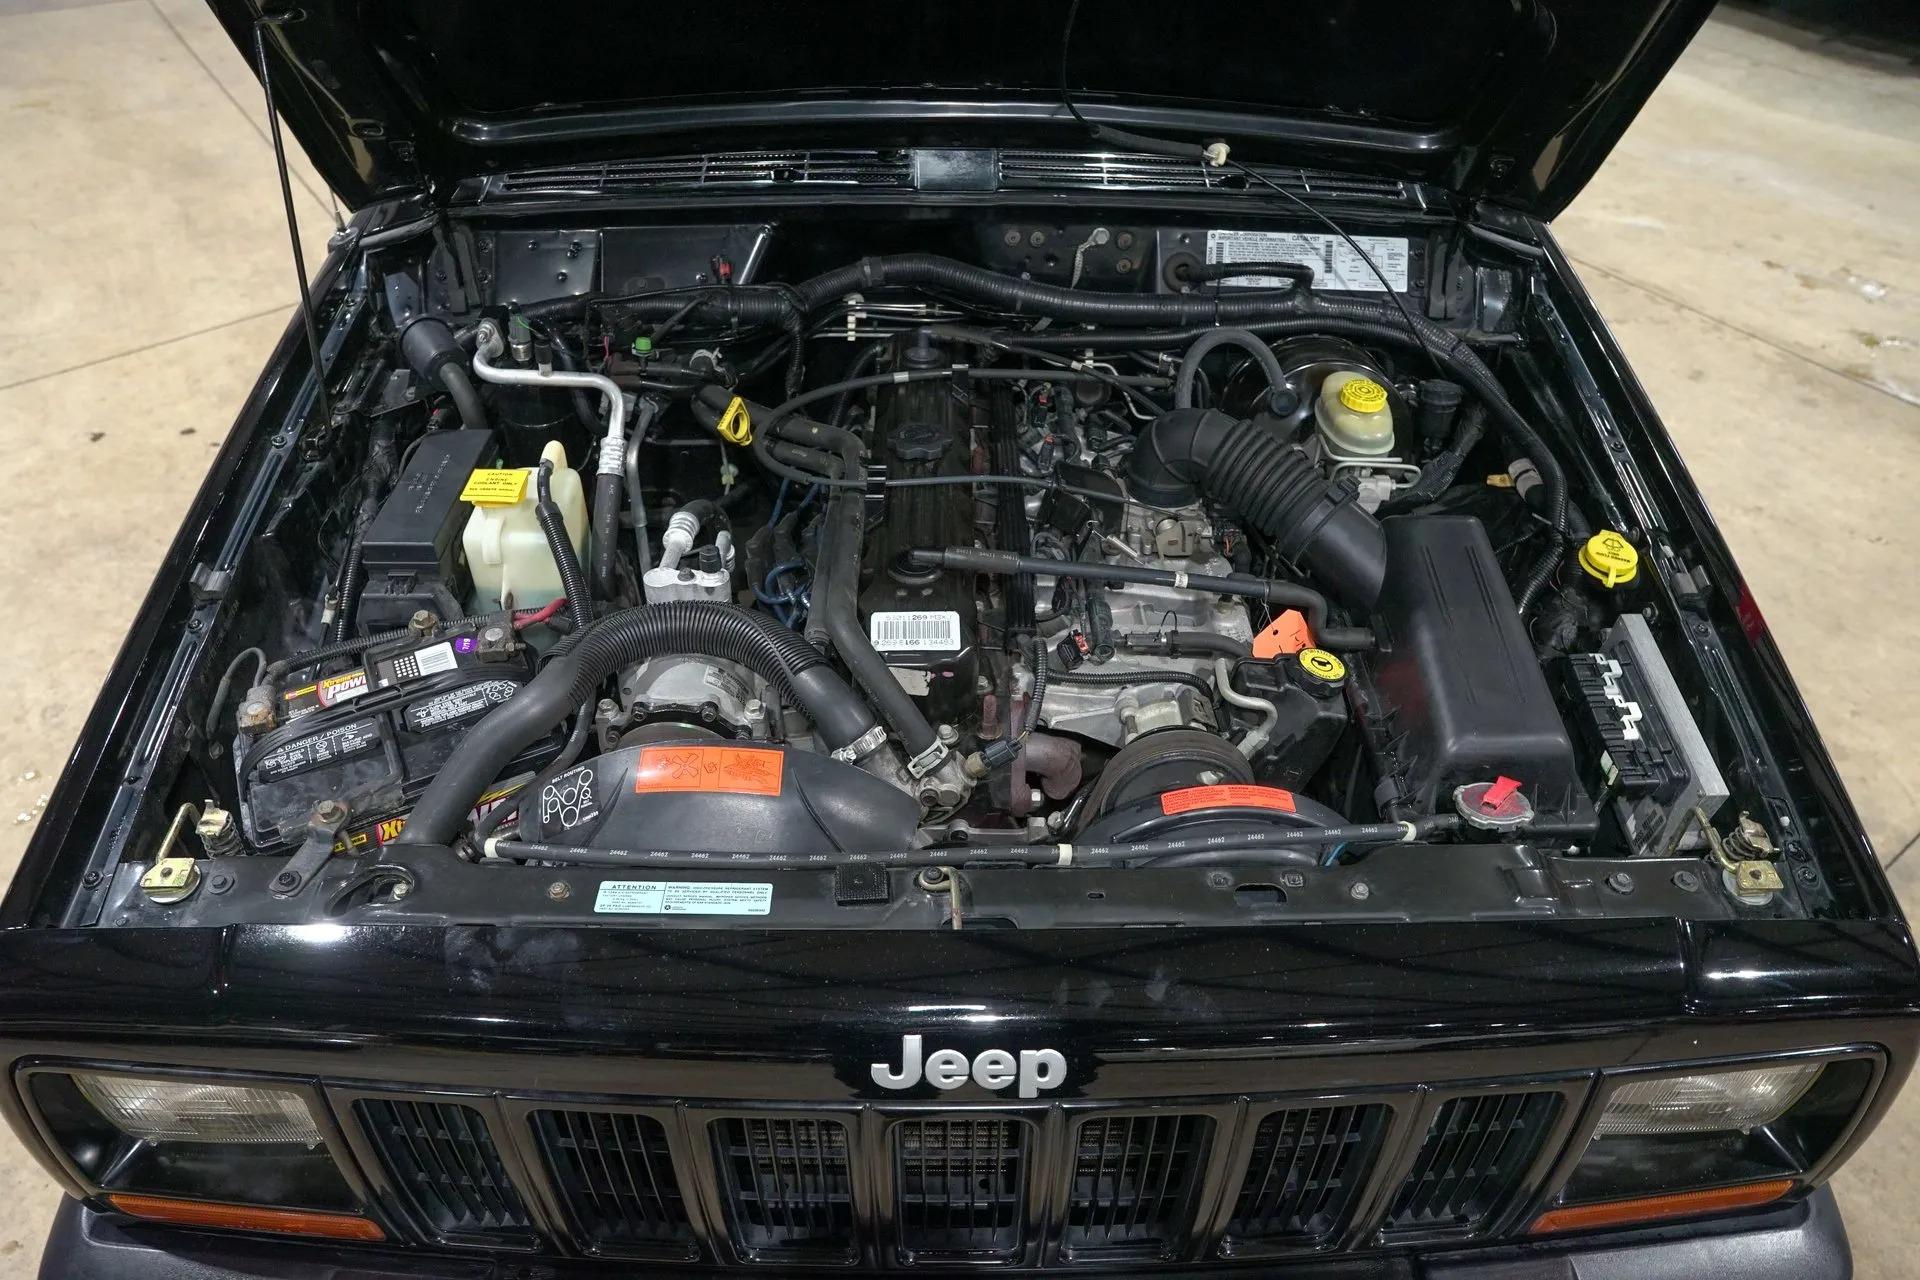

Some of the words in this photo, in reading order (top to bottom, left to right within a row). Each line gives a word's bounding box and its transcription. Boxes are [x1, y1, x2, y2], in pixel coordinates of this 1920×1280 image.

[285, 735, 318, 751] DANGER
[326, 723, 357, 737] POISON
[551, 774, 563, 784] BELT
[563, 765, 585, 778] ROUTING
[870, 1034, 1067, 1099] Jeep
